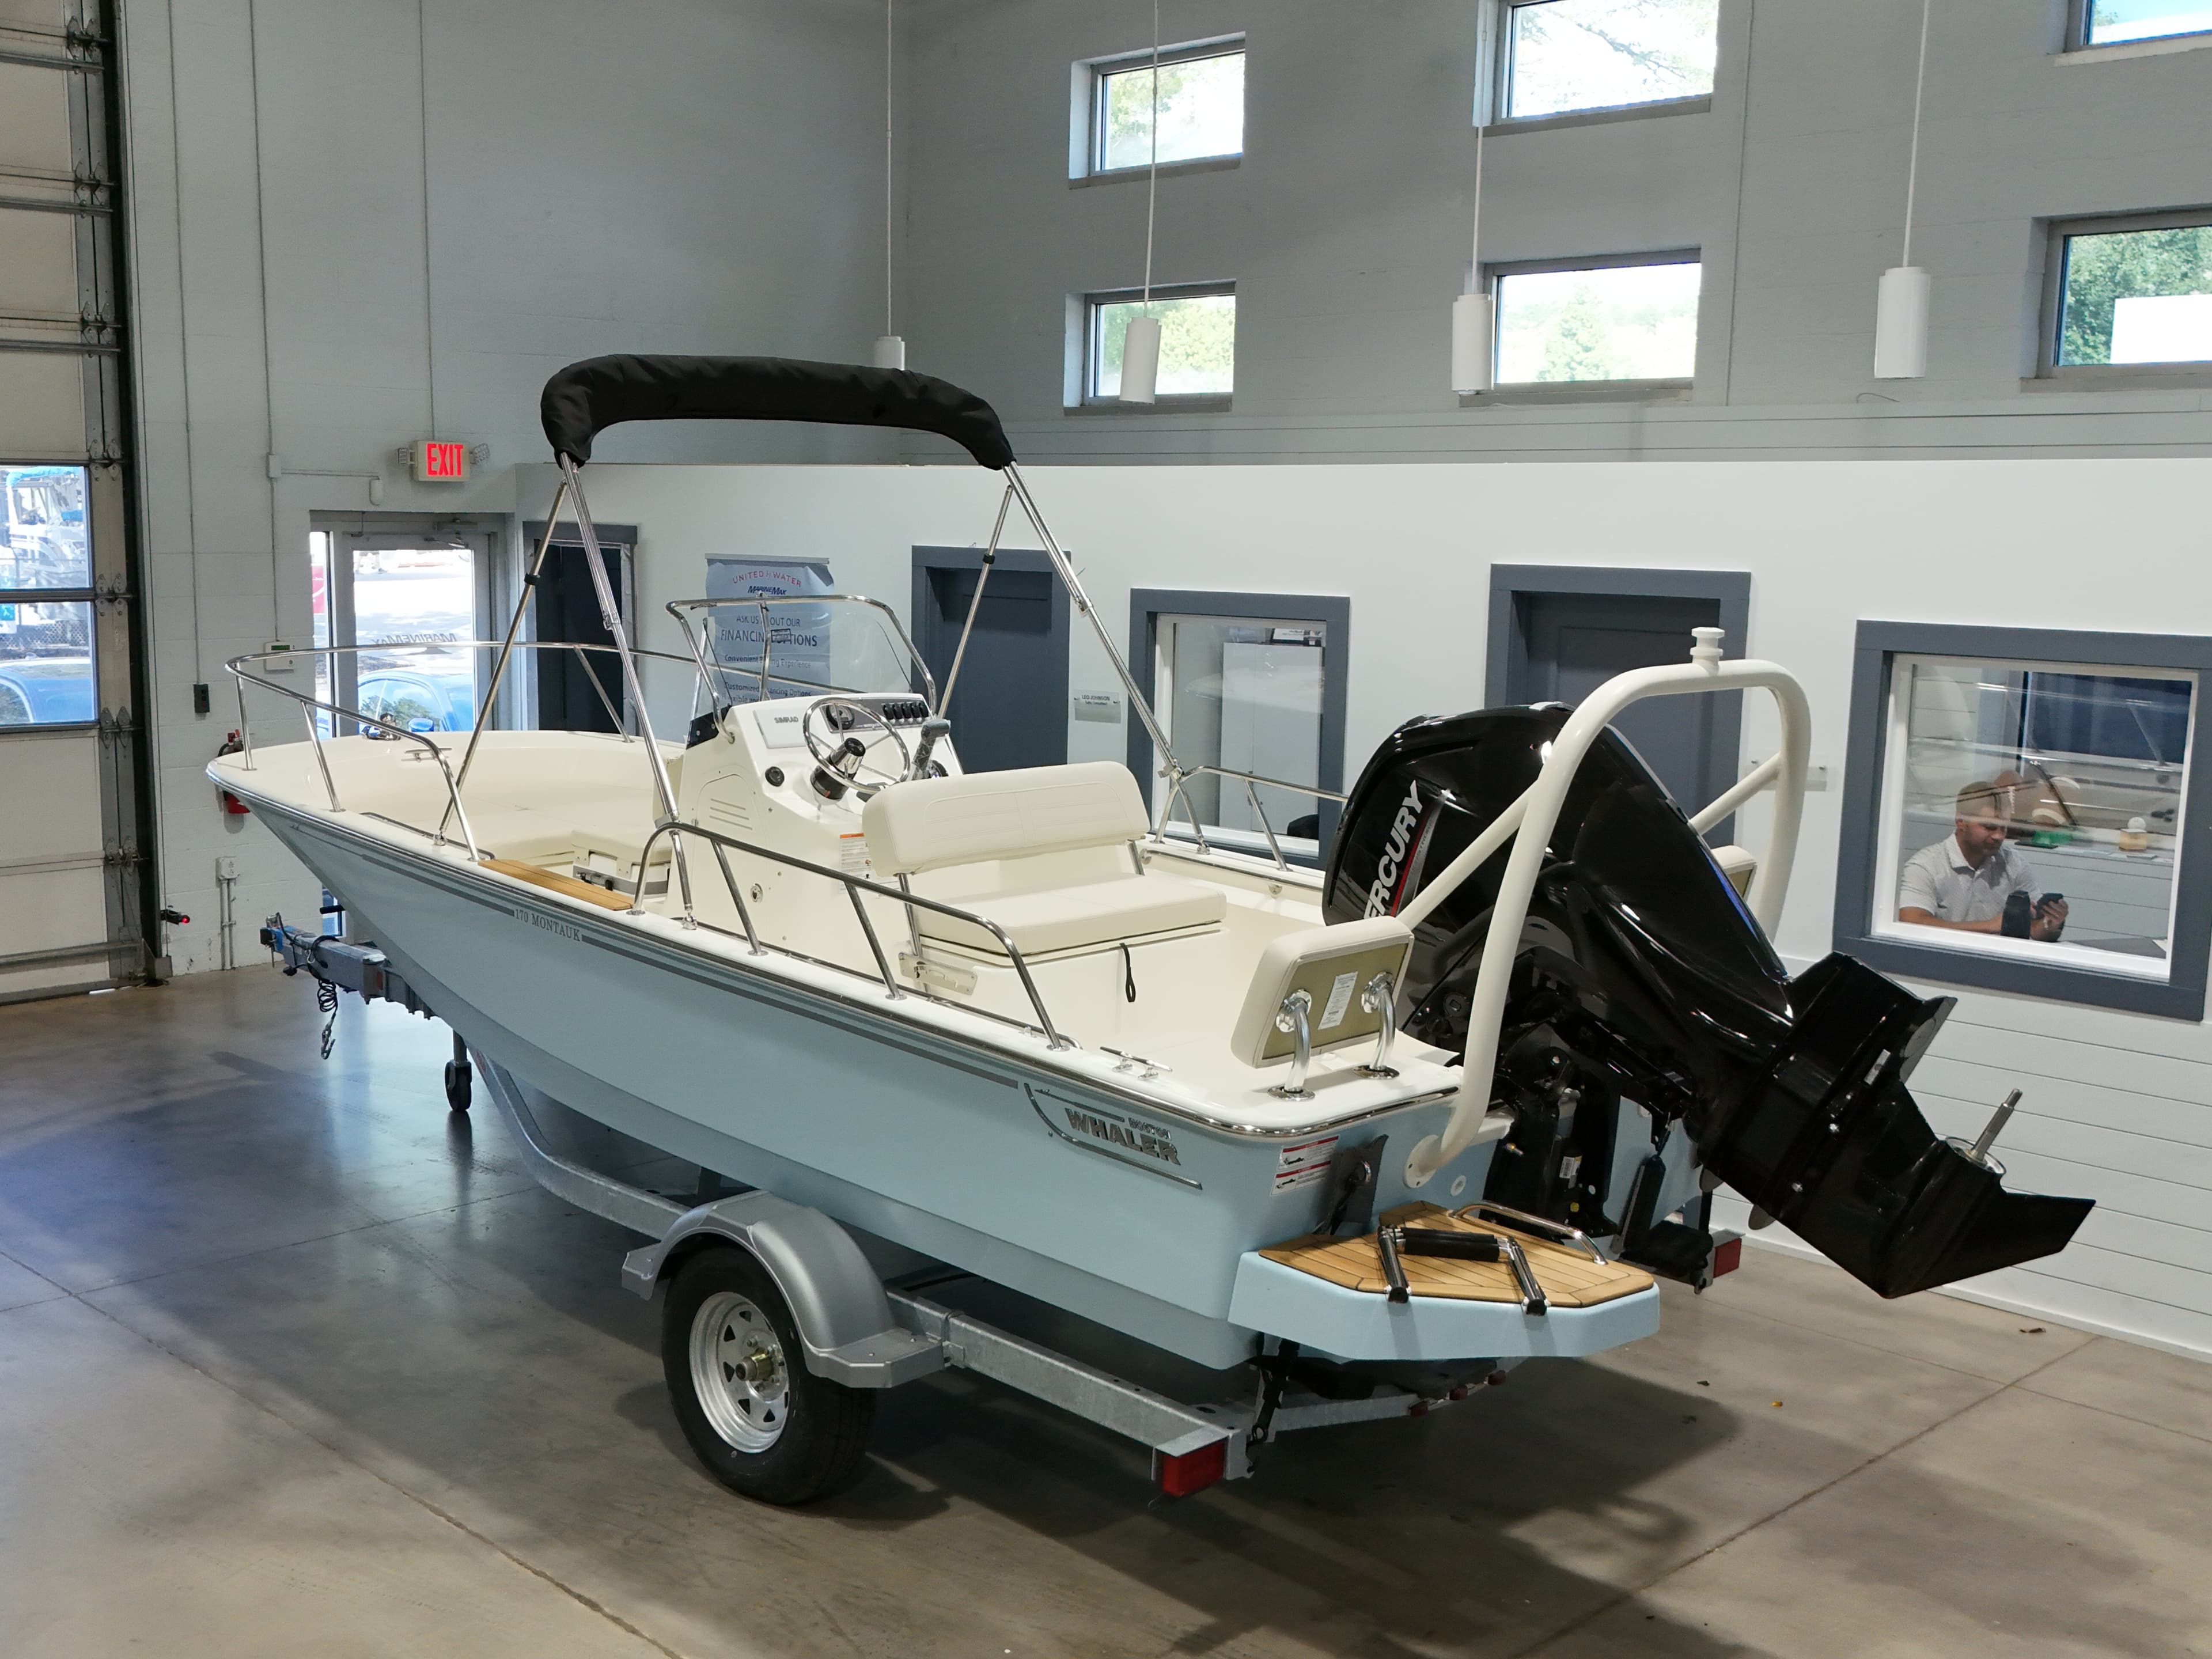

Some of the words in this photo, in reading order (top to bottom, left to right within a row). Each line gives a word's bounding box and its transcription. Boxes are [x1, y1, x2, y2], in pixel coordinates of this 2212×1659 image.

[426, 443, 463, 476] EXIT
[733, 571, 764, 584] UNITED
[773, 572, 801, 588] WATER
[737, 615, 749, 624] ASK
[751, 616, 759, 624] US
[786, 618, 800, 627] OUR
[721, 630, 764, 642] FINANCIN
[725, 654, 758, 662] Convenient
[781, 658, 811, 668] Experience
[774, 716, 798, 724] SIMRAD
[1364, 779, 1423, 921] ERCURY
[516, 909, 528, 922] 170
[532, 913, 581, 941] MONTAUK
[1065, 1107, 1181, 1166] WHALER
[1128, 1117, 1171, 1140] BOSTON
